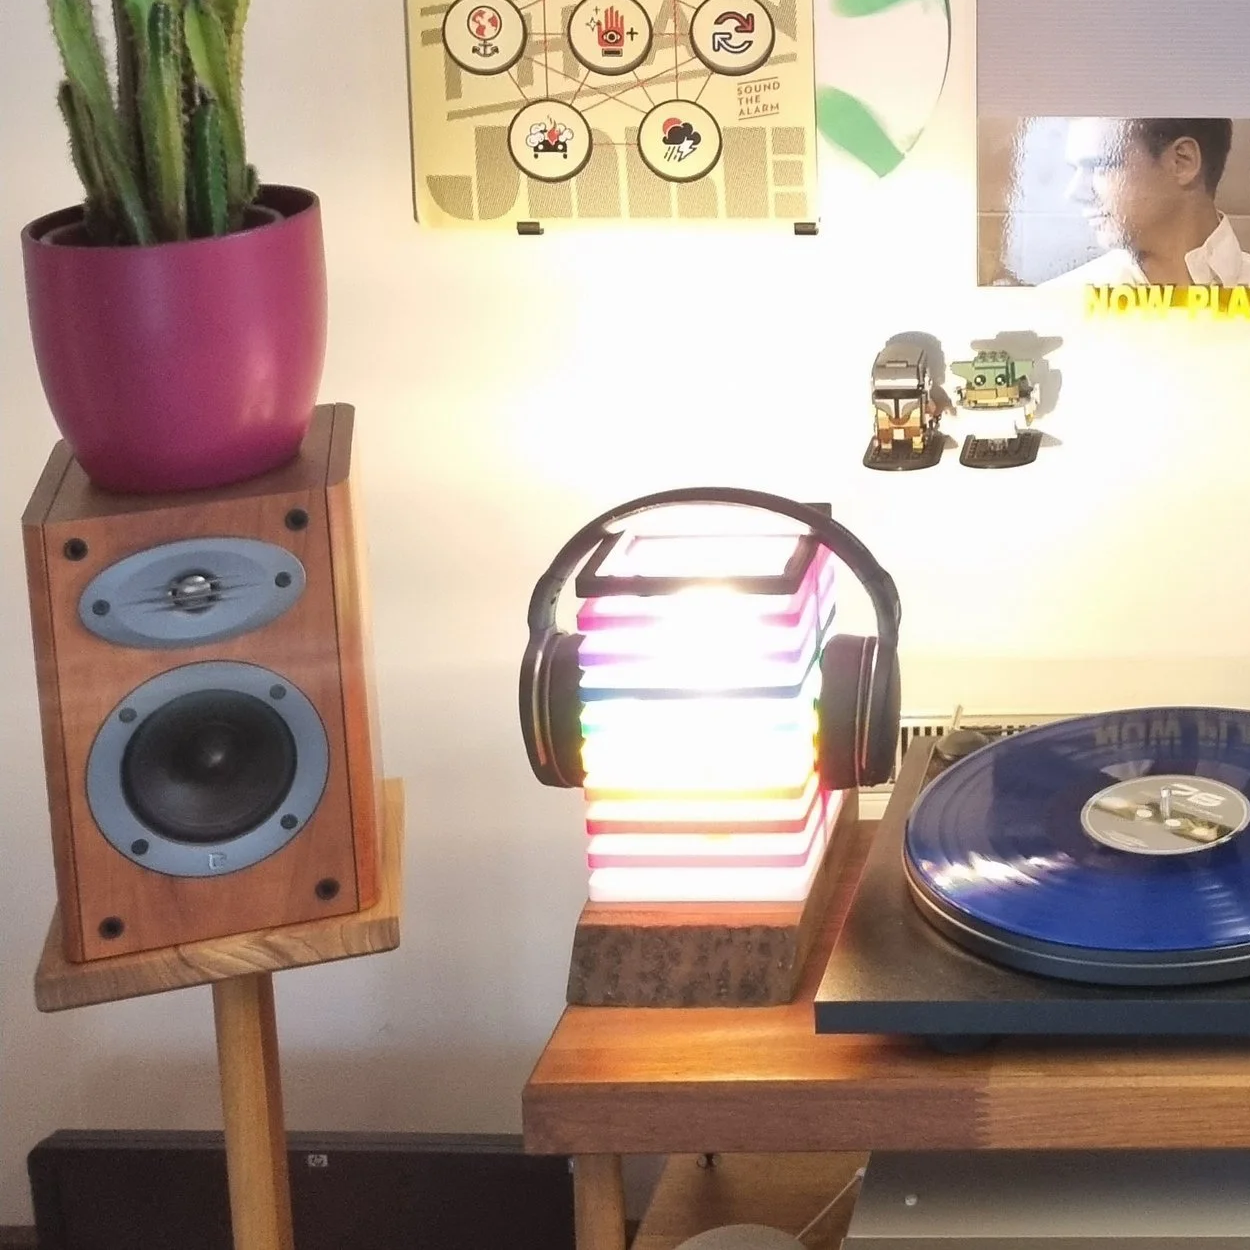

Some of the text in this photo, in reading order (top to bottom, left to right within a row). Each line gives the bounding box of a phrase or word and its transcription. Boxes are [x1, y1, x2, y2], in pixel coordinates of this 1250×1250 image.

[737, 81, 780, 96] SOUND
[737, 94, 761, 106] THE
[738, 103, 779, 117] ALARM
[1085, 283, 1175, 318] NOW
